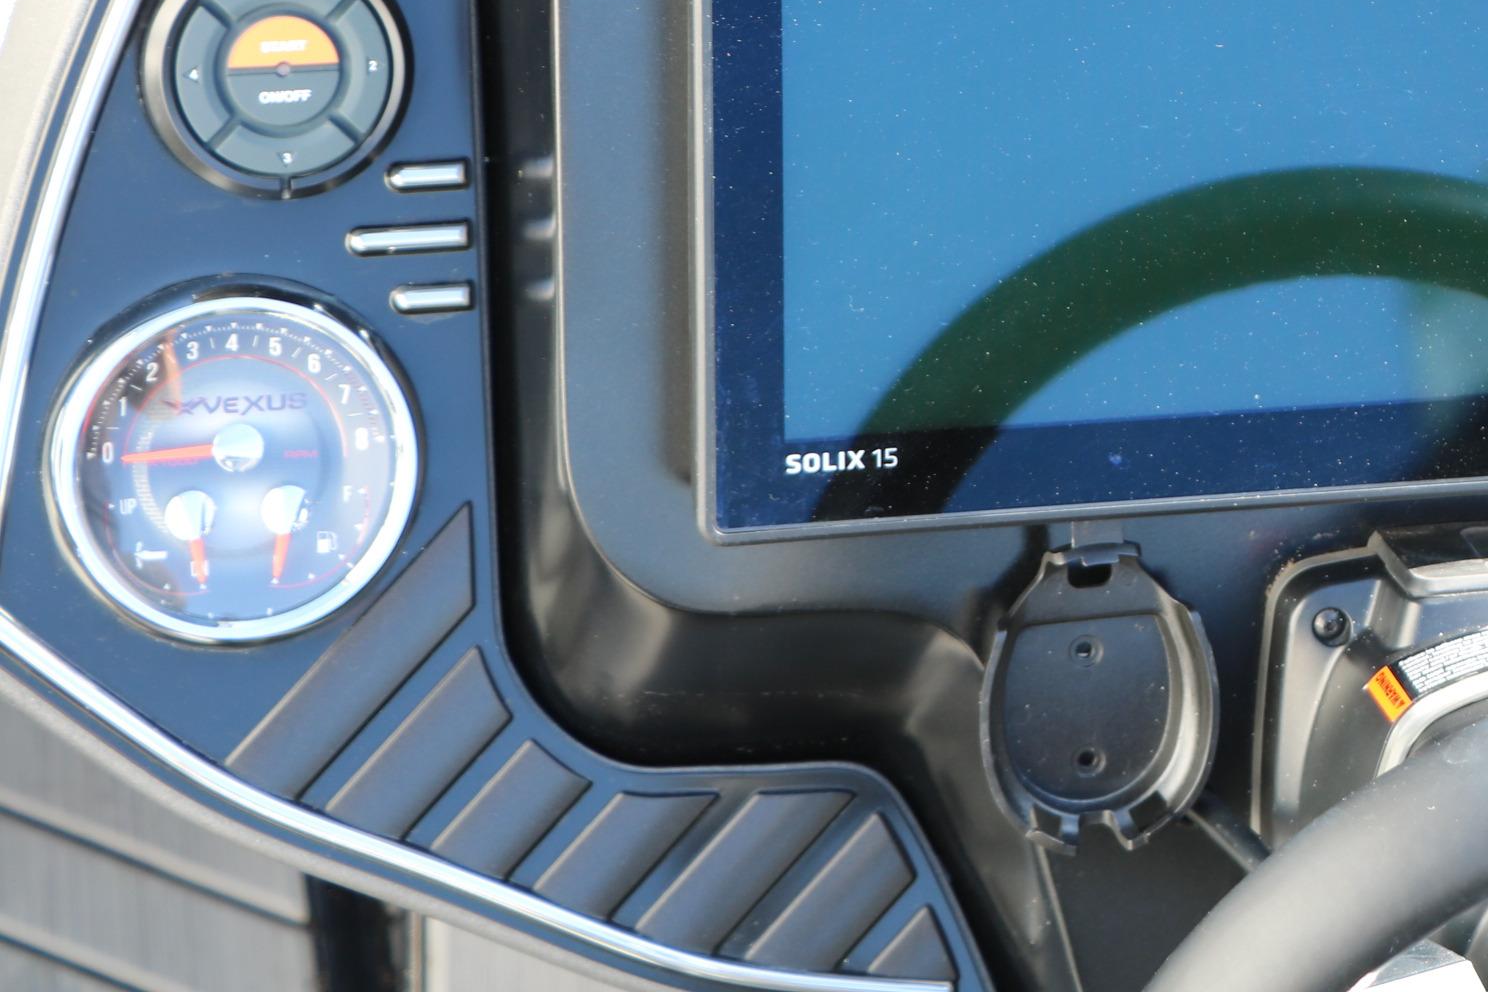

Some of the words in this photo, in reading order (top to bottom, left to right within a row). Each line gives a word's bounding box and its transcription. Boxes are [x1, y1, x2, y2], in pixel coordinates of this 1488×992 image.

[188, 69, 199, 80] 4
[368, 60, 378, 72] 2
[259, 90, 311, 103] ON/OFF
[281, 153, 293, 164] 3
[187, 341, 199, 360] 3
[225, 333, 239, 351] 4
[269, 337, 282, 356] 5
[308, 353, 321, 373] 6
[146, 363, 158, 383] 2
[339, 384, 351, 404] 7
[119, 400, 127, 417] 1
[201, 393, 307, 415] VEXUS
[354, 428, 369, 450] 8
[102, 442, 114, 463] 0
[785, 449, 866, 475] SOLIX
[871, 447, 899, 468] 15
[342, 486, 352, 504] F
[120, 499, 137, 515] UP
